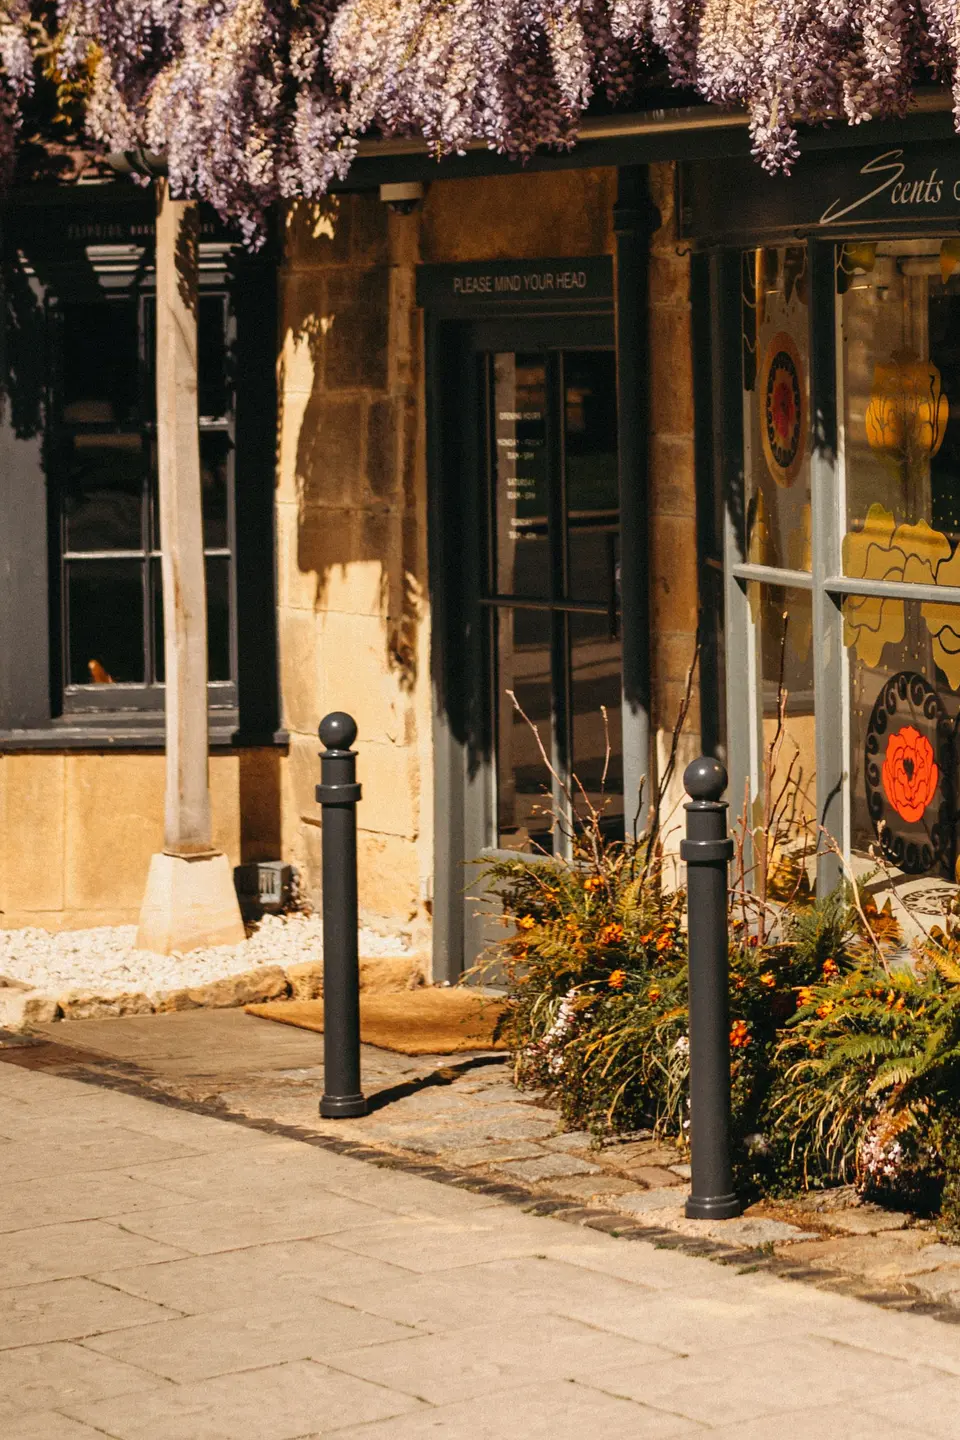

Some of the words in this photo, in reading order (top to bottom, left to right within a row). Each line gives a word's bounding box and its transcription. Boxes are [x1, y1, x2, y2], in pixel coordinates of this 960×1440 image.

[819, 148, 944, 224] Scents
[453, 276, 493, 293] PLEASE
[495, 275, 521, 291] MIND
[524, 272, 554, 291] YOUR
[556, 271, 587, 289] HEAD
